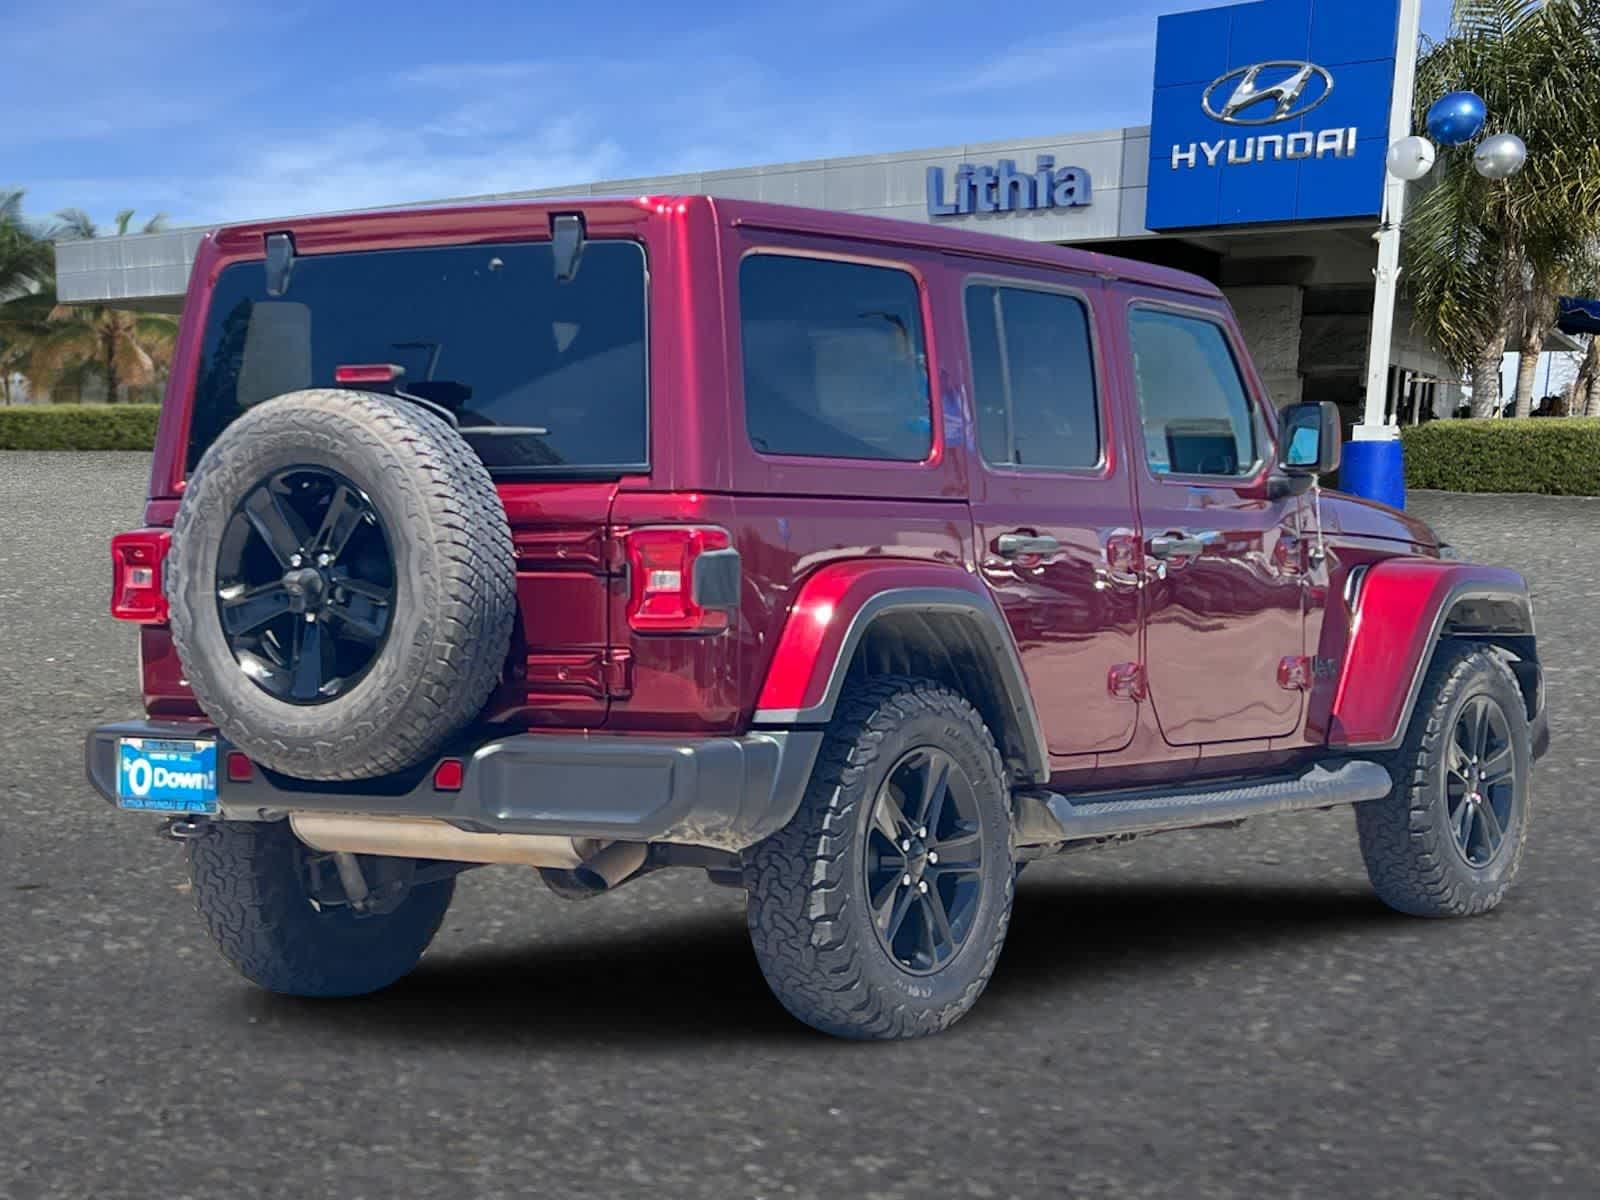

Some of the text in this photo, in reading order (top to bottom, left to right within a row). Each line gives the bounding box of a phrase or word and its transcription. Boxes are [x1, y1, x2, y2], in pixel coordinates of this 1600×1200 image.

[1171, 126, 1358, 169] HYUNDAI
[926, 154, 1093, 217] Lithia
[153, 767, 216, 790] Down!
